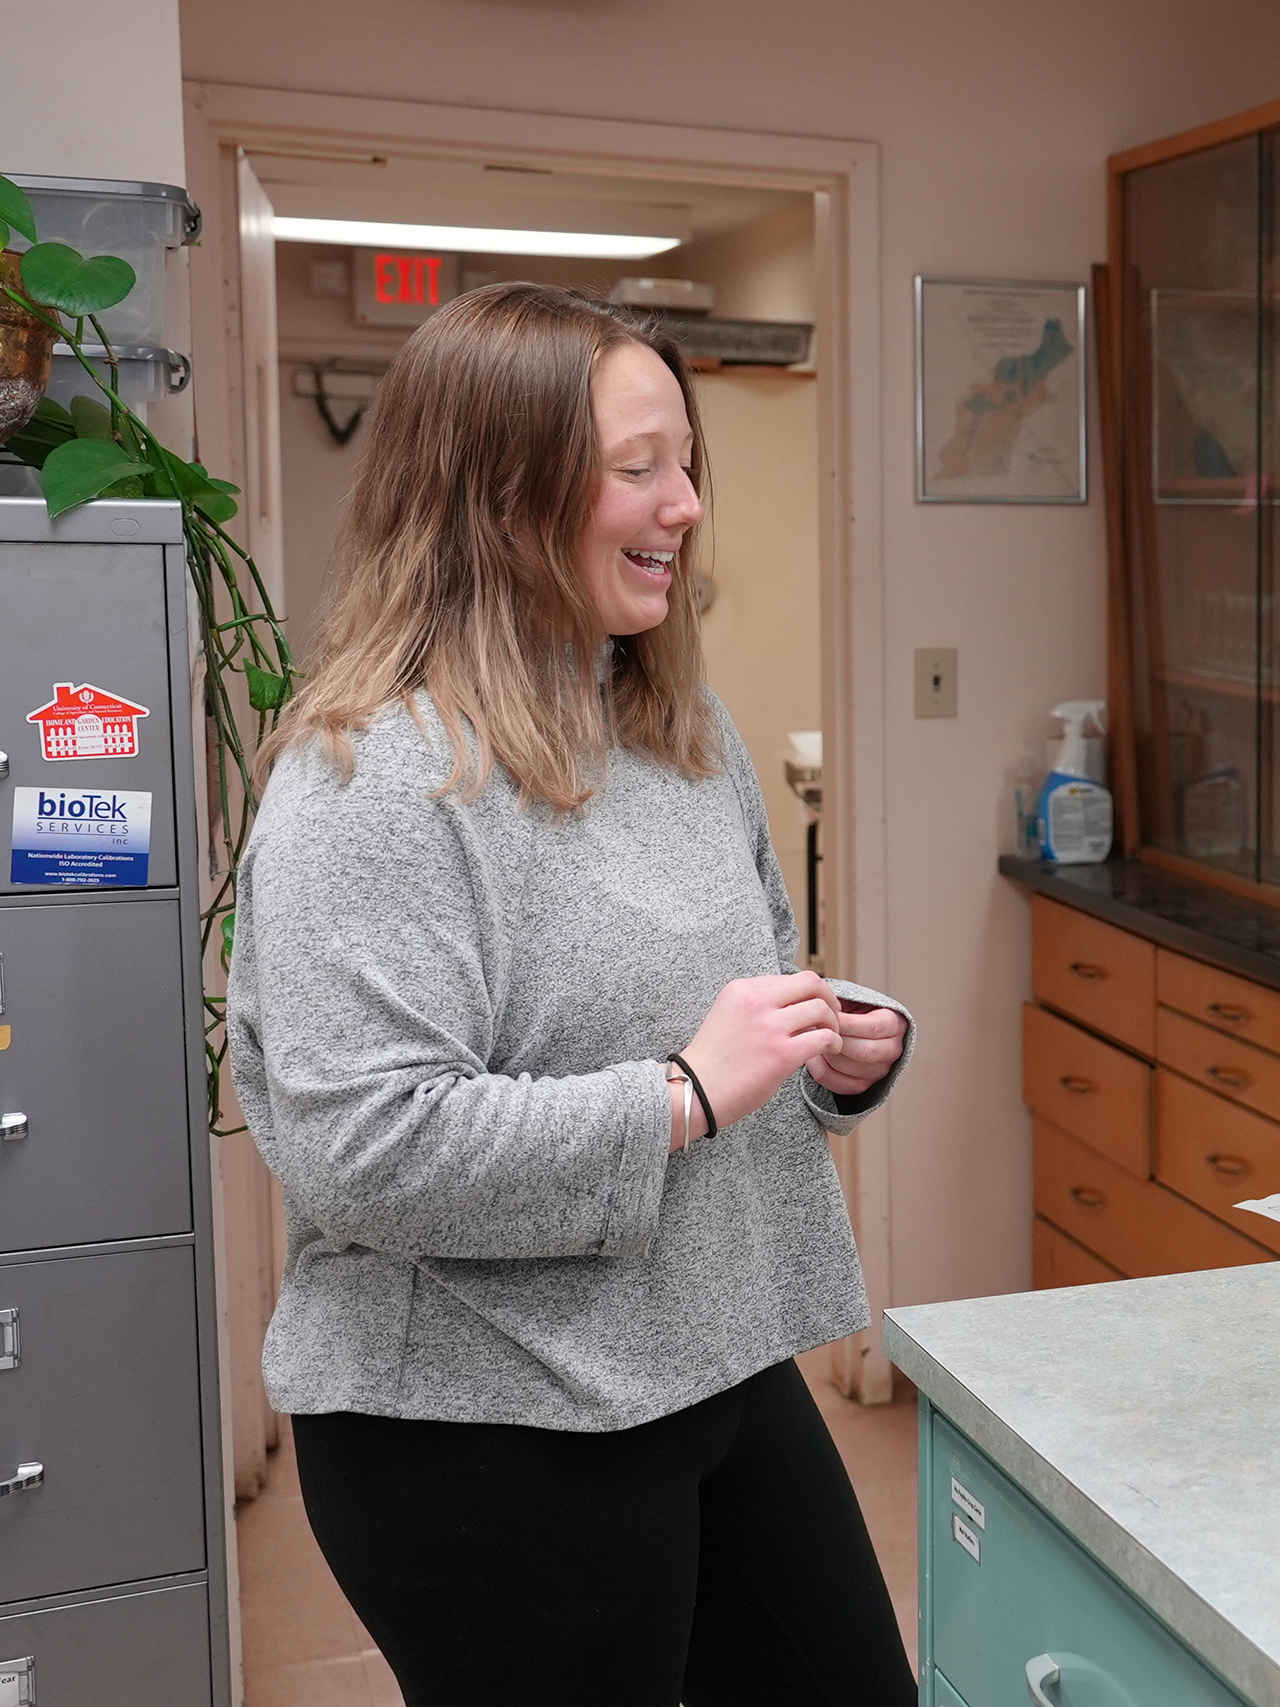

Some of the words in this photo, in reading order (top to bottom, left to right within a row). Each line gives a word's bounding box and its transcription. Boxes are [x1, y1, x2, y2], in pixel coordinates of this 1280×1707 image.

[375, 253, 443, 306] EXIT
[38, 792, 127, 819] bioTek
[36, 822, 129, 834] SERVICES
[27, 852, 63, 860] Nationwide
[64, 853, 97, 861] Laboratory
[98, 854, 134, 862] Calibrations
[0, 1675, 16, 1684] ear
